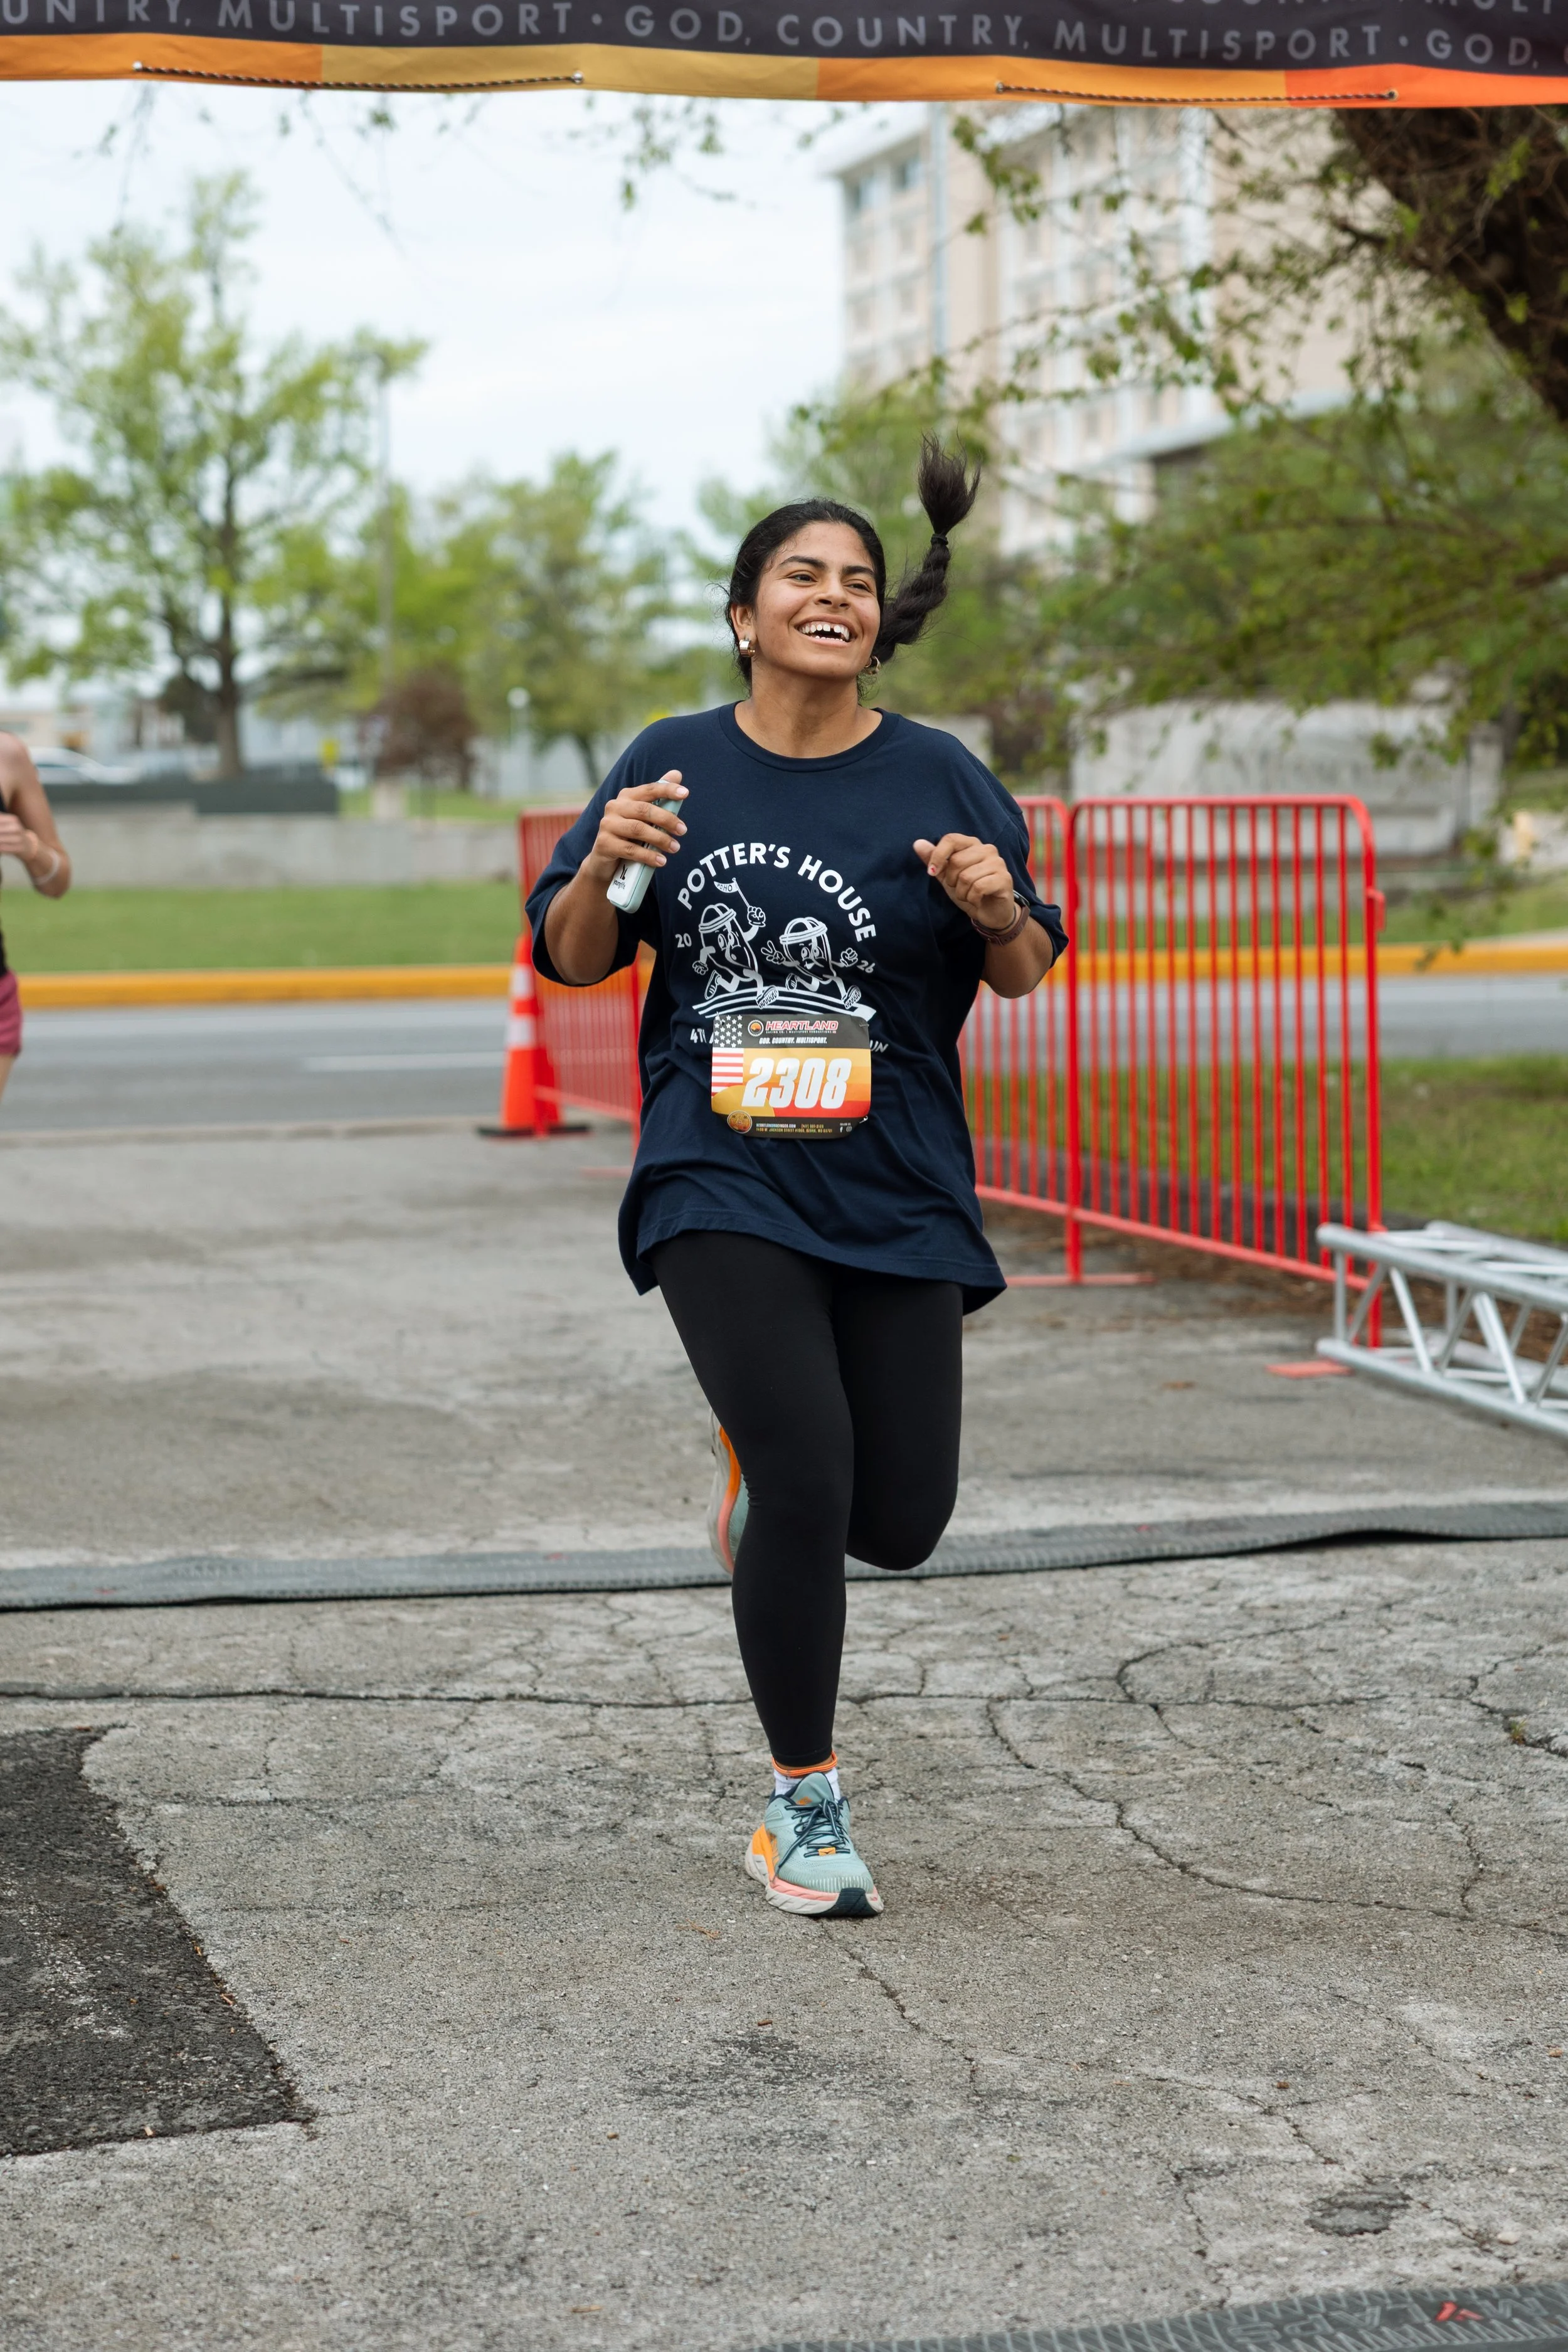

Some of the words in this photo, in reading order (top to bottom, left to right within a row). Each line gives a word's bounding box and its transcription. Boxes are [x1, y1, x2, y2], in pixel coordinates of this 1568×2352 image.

[217, 0, 572, 37] MULTISPORT
[625, 4, 751, 46] GOD,
[776, 14, 1030, 50] COUNTRY,
[1053, 21, 1382, 61] MULTISPORT
[1426, 29, 1539, 69] GOD,
[677, 842, 791, 911] POTTER'S
[797, 854, 877, 943] HOUSE
[675, 933, 692, 948] 20
[857, 960, 876, 973] 26
[765, 1020, 839, 1030] HEARTLAND
[741, 1057, 852, 1110] 2308
